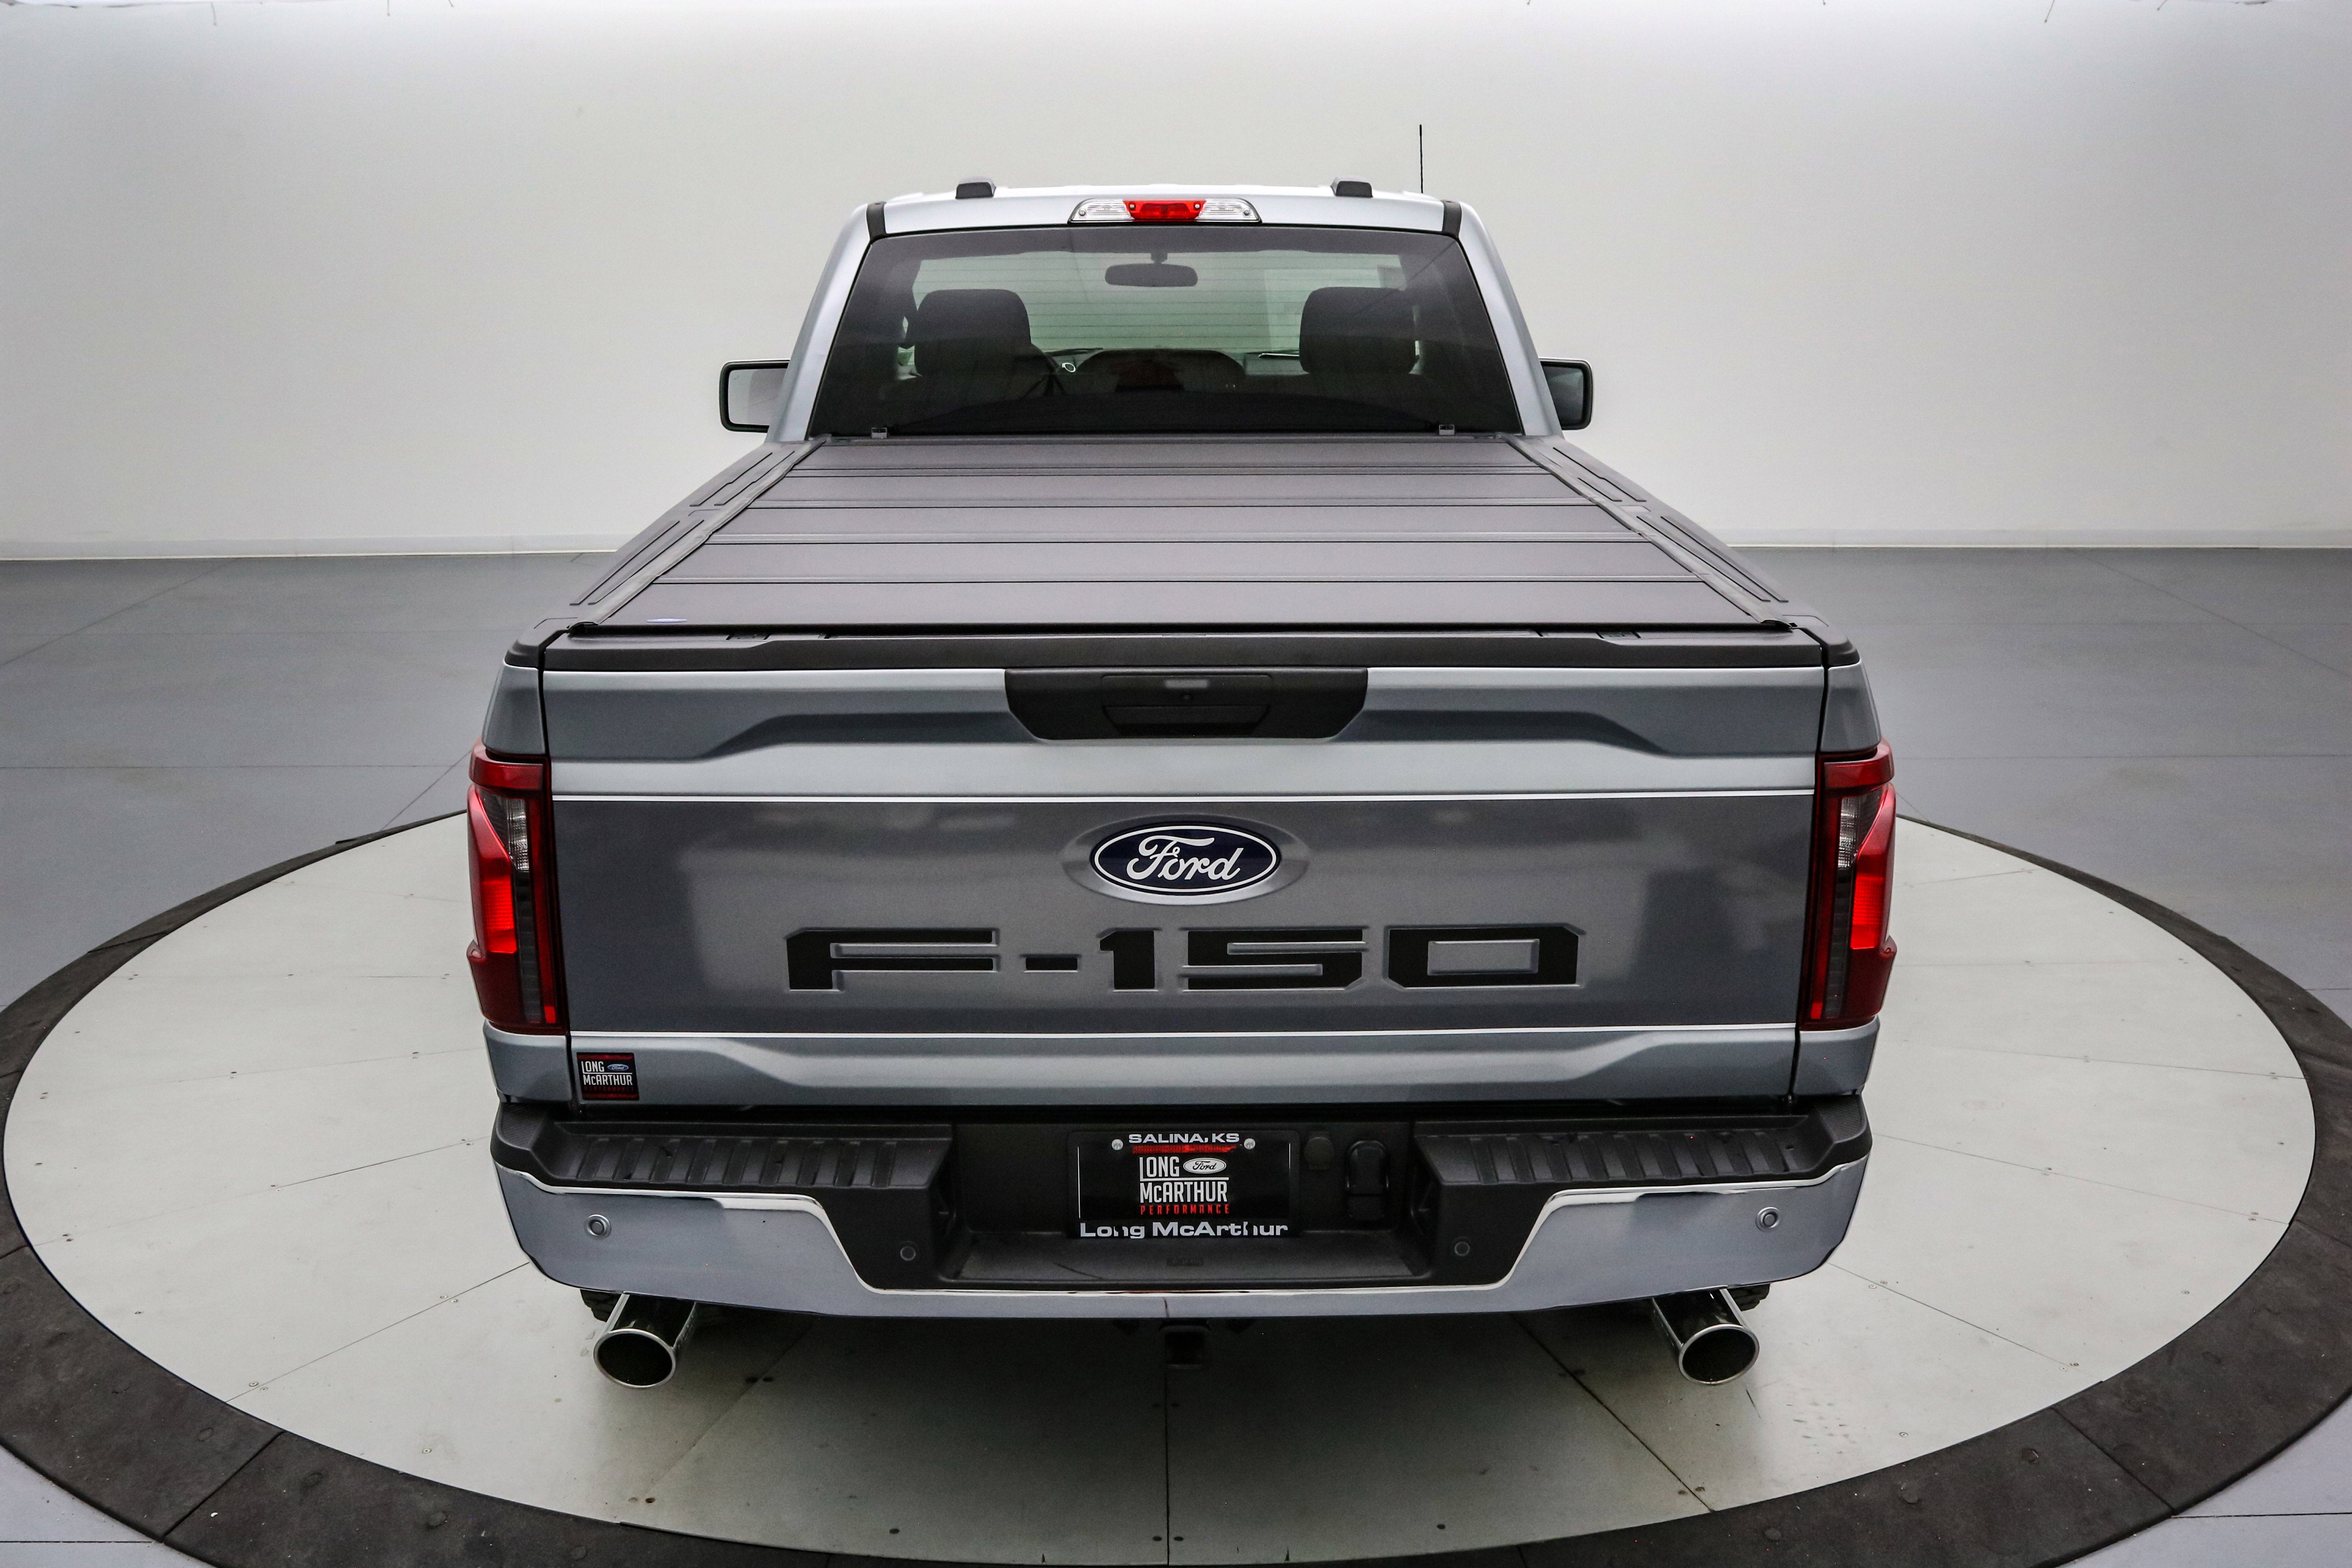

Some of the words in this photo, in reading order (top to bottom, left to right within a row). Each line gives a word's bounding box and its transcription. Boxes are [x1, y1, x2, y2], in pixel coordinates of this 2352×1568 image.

[1127, 835, 1244, 880] Ford
[786, 925, 1580, 991] F-150
[581, 1061, 605, 1073] LONG
[1129, 1133, 1209, 1143] SALINA,
[1212, 1133, 1240, 1143] KS
[1139, 1156, 1180, 1181] LONG
[1192, 1160, 1217, 1170] Ford
[1141, 1204, 1229, 1215] PERFORMANCE
[1080, 1222, 1145, 1239] Long
[1153, 1221, 1288, 1236] McArthur
